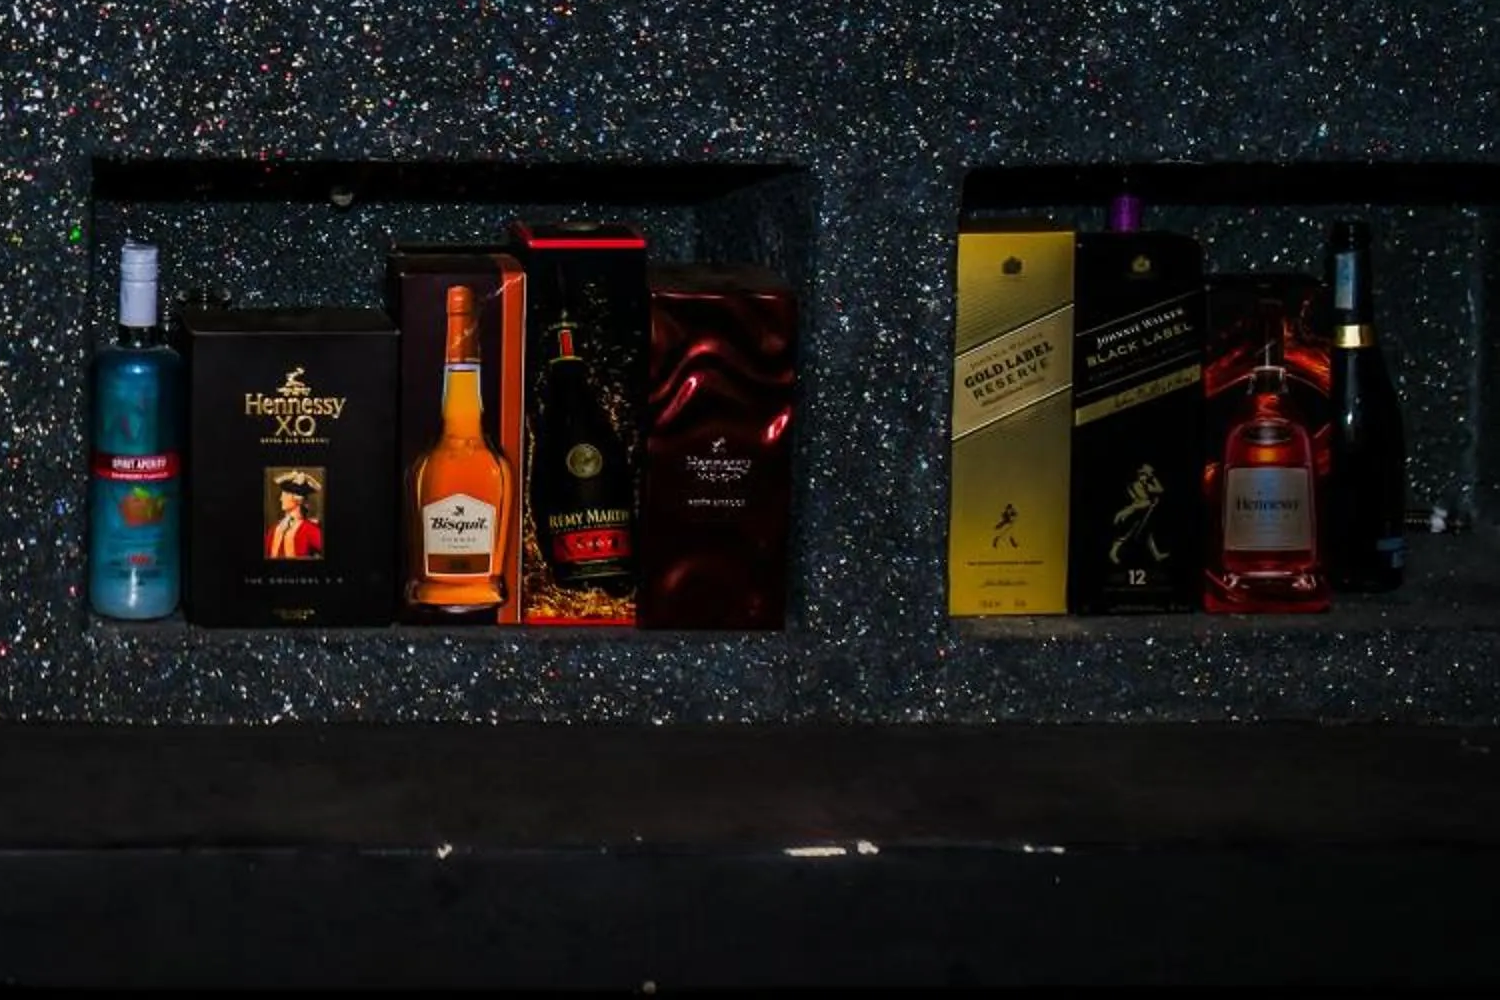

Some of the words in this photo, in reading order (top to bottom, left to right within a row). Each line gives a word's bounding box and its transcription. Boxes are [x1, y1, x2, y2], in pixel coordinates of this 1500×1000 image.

[1086, 340, 1139, 369] BLACK
[1141, 323, 1194, 347] LABEL
[963, 361, 1004, 389] GOLD
[1004, 340, 1054, 369] LABEL
[972, 357, 1049, 401] RESERVE
[244, 393, 347, 419] Hennessy
[275, 415, 317, 437] X.O
[430, 517, 487, 534] Bisquit
[1128, 569, 1147, 585] 12
